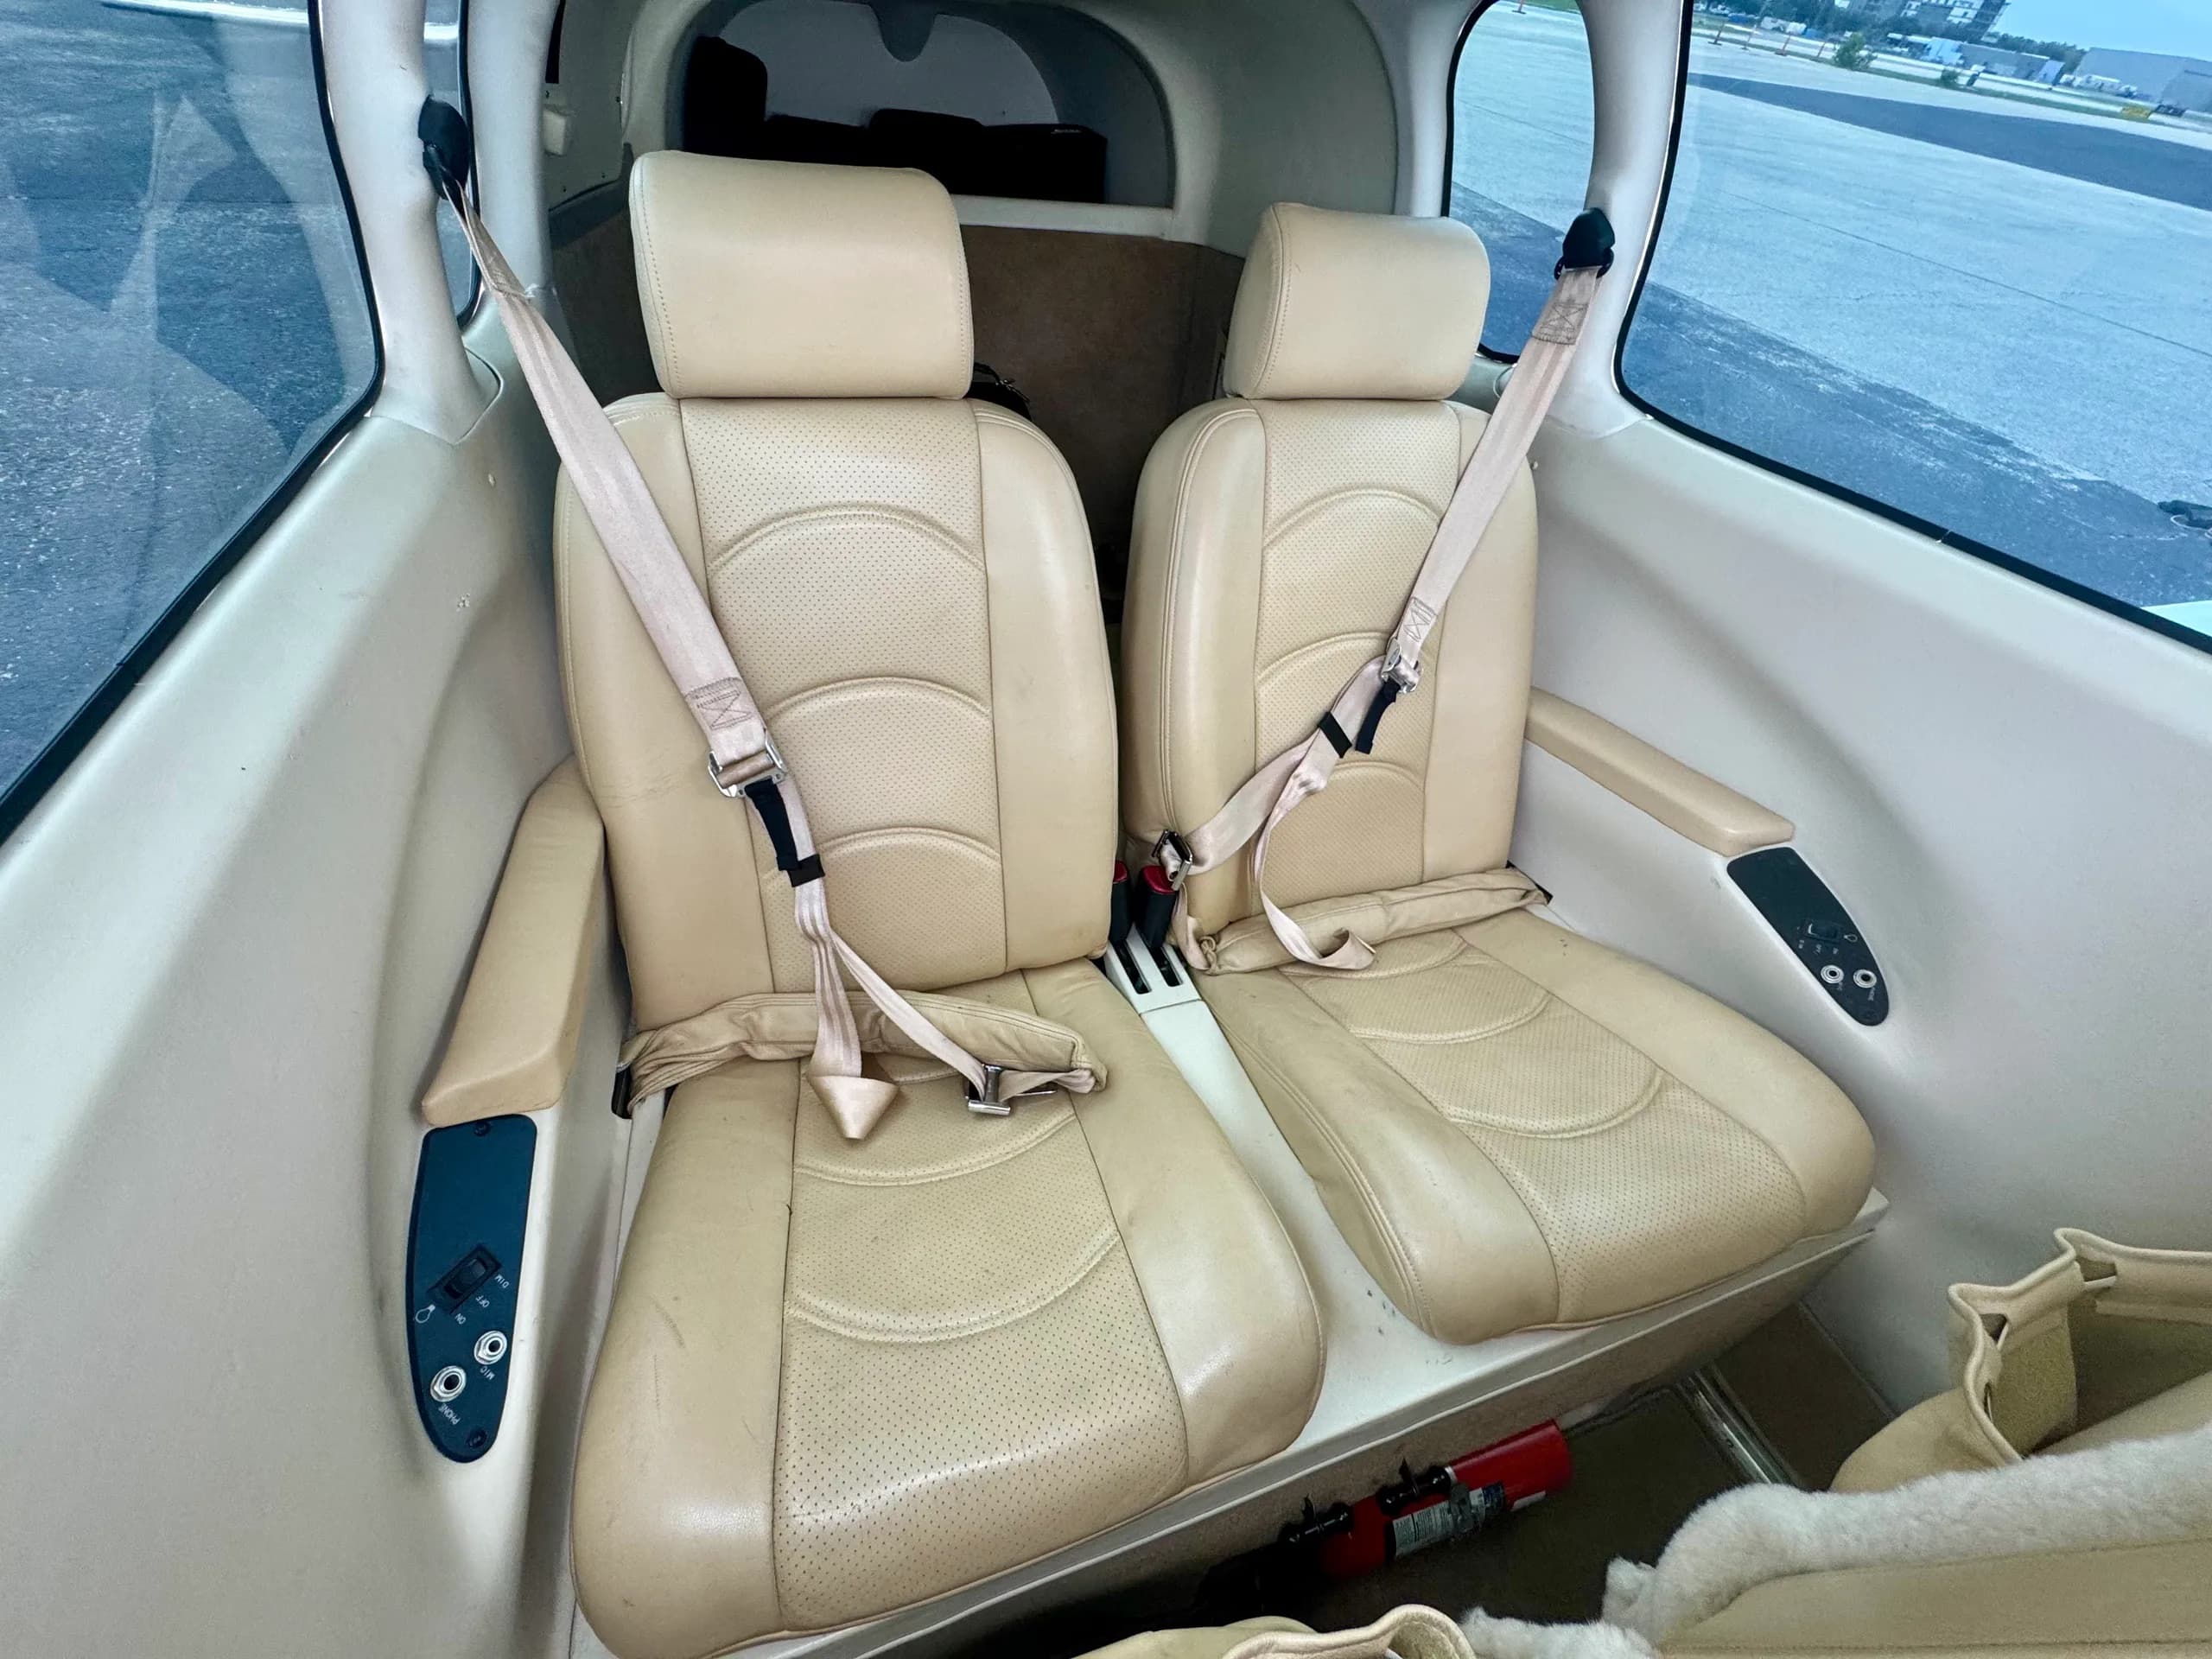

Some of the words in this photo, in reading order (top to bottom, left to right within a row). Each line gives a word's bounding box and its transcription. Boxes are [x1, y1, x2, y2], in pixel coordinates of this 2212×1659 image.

[494, 1274, 510, 1288] DIM
[475, 1295, 490, 1308] OFF
[454, 1313, 467, 1325] ON
[480, 1365, 495, 1380] MIC
[438, 1403, 461, 1425] PHONE
